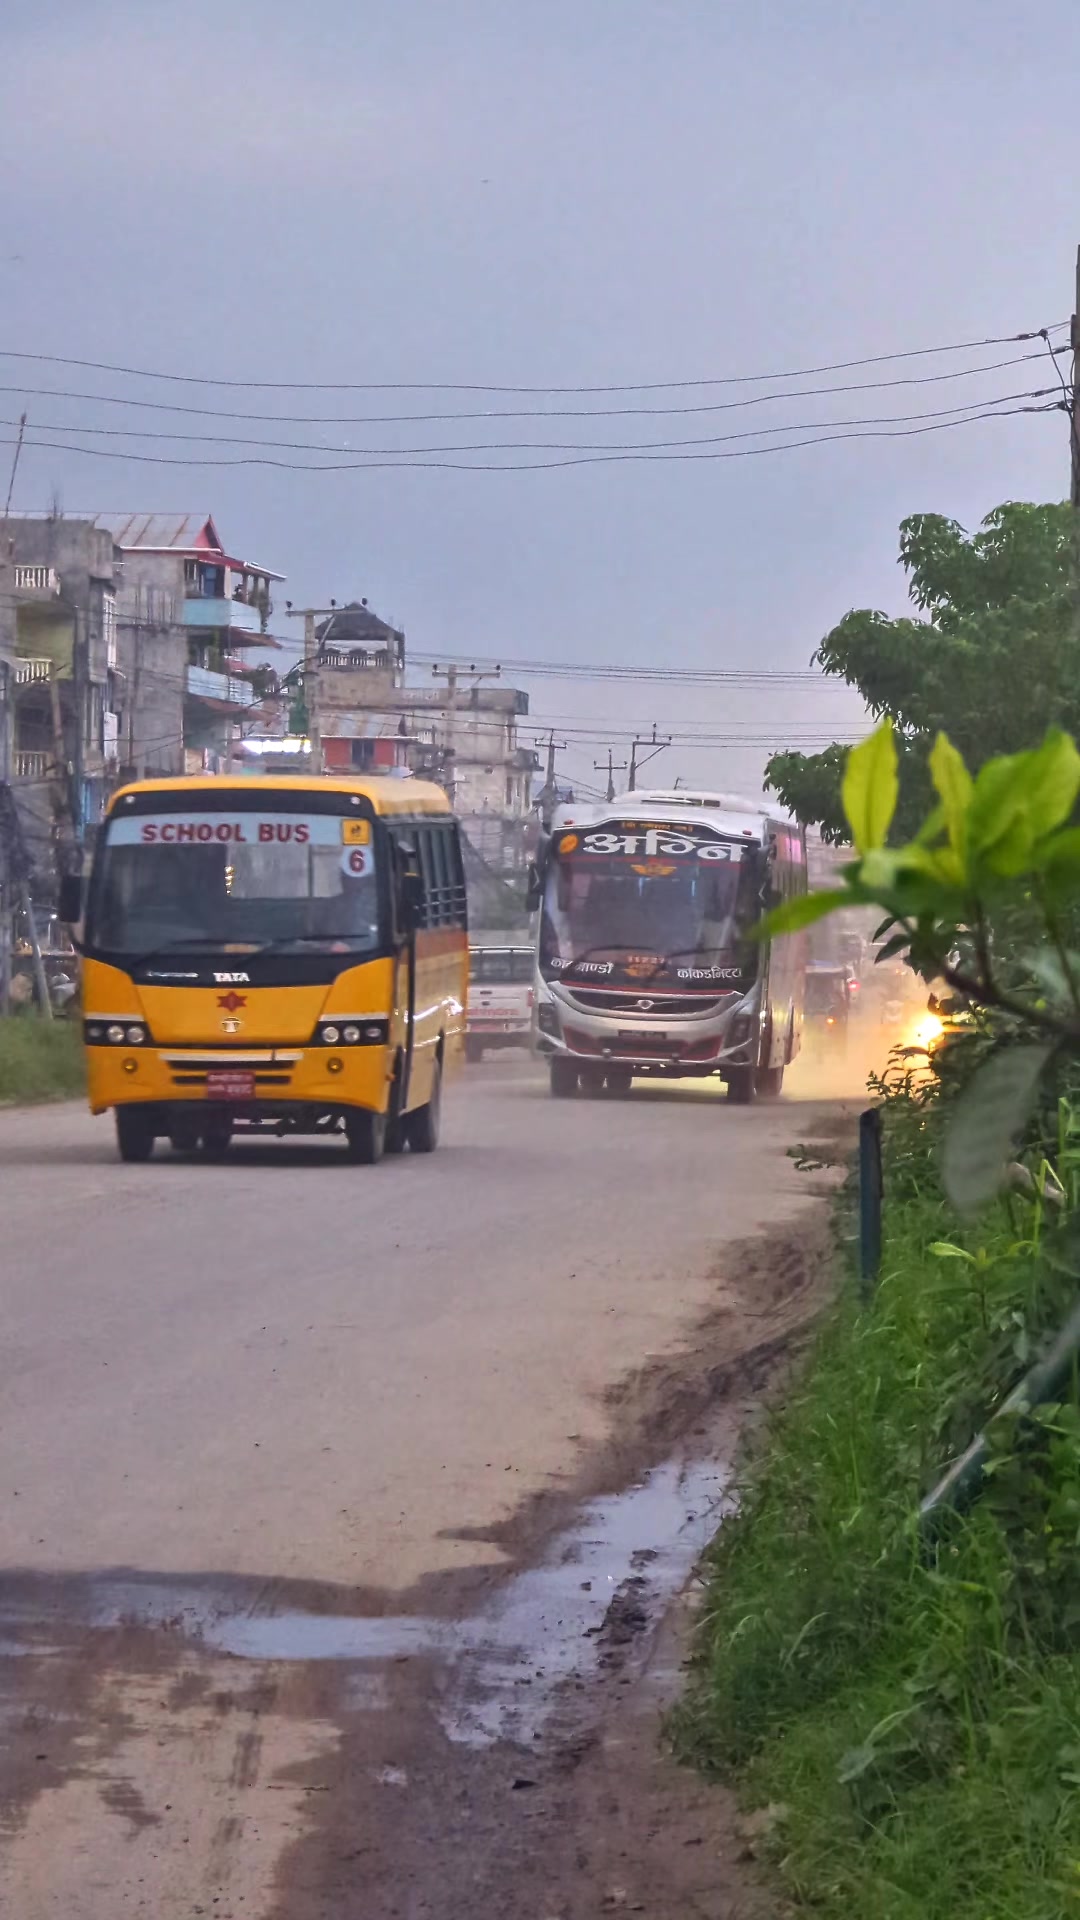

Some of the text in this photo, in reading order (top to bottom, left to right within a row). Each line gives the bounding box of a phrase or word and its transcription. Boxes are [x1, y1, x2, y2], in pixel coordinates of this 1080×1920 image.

[141, 823, 310, 843] SCHOOL BUS
[350, 849, 365, 873] 6
[213, 972, 250, 982] TATA
